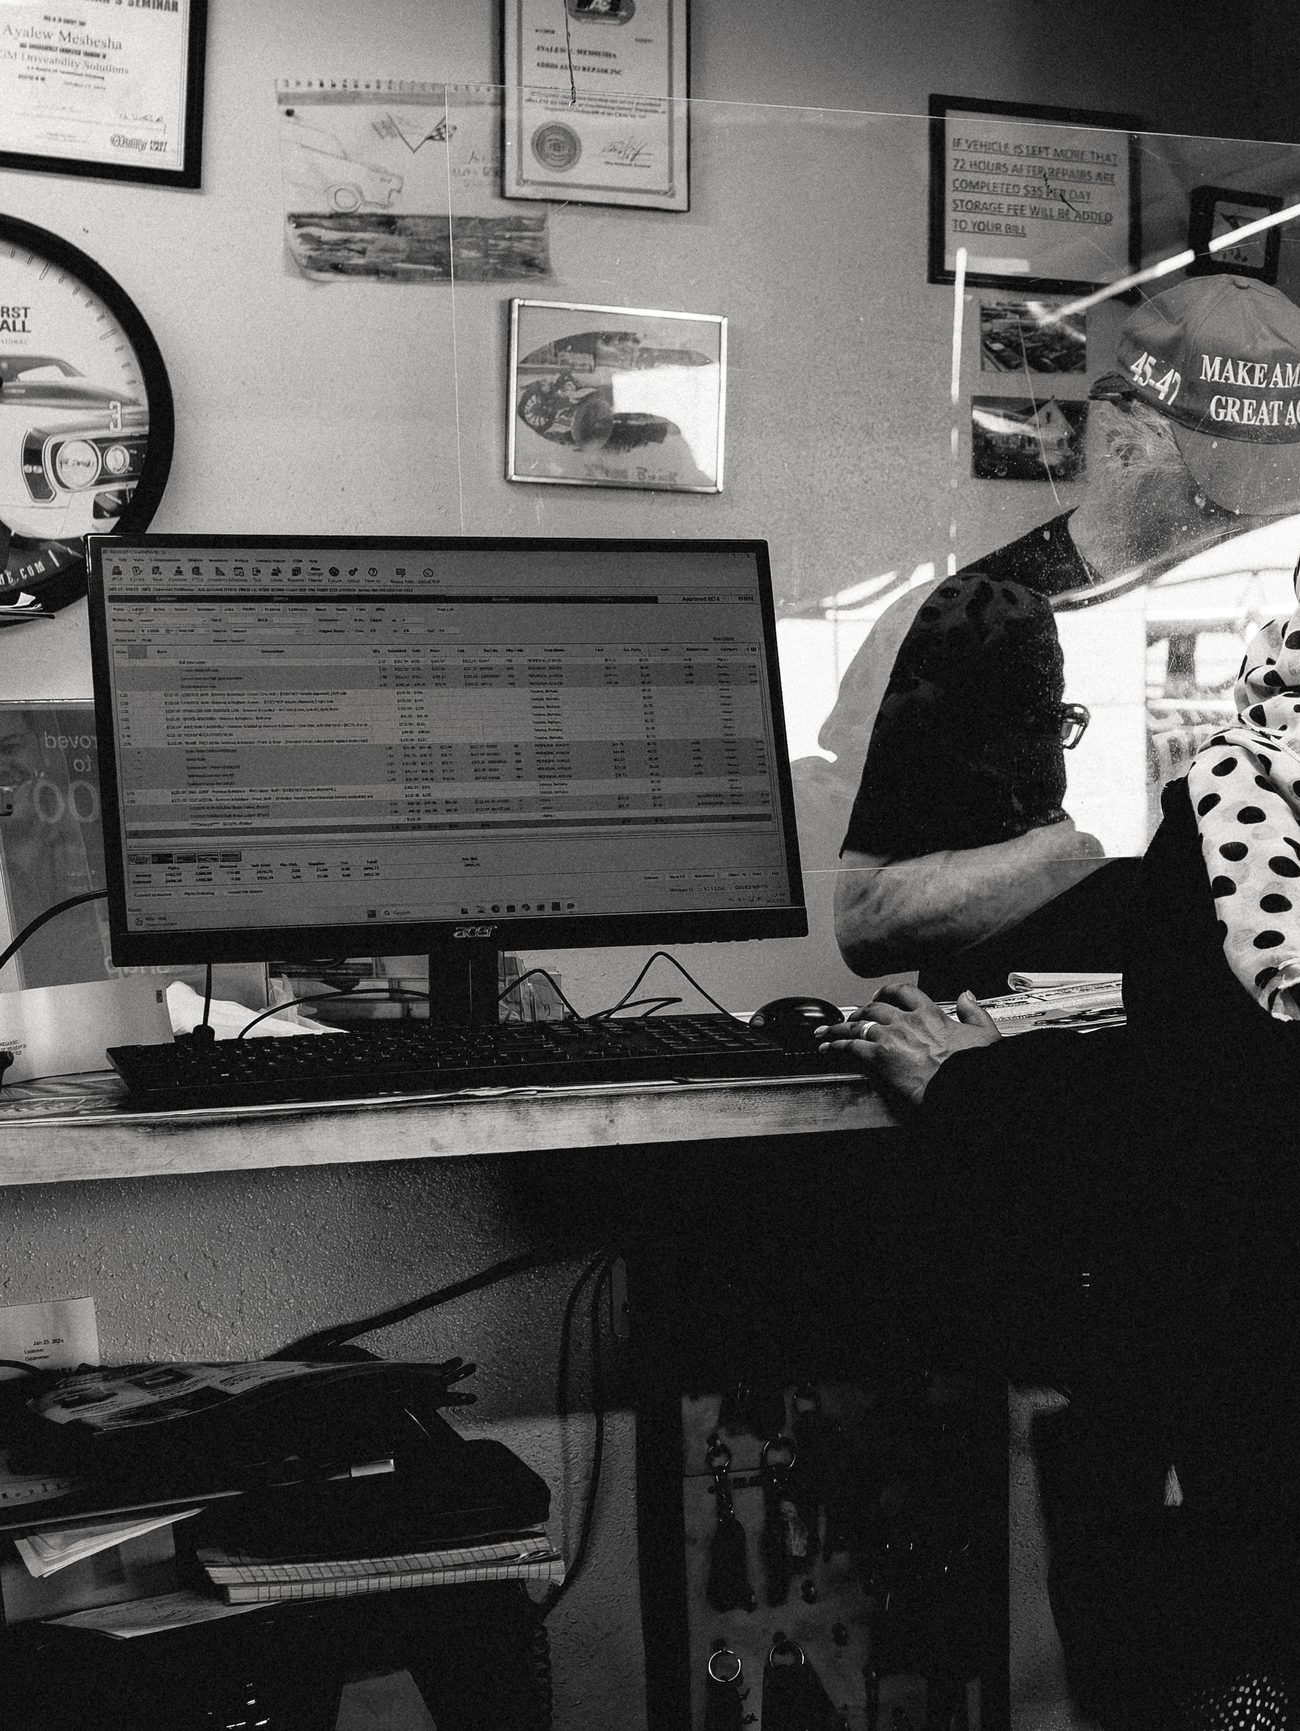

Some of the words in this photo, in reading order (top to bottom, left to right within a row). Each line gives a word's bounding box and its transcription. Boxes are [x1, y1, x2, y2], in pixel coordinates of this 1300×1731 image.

[3, 23, 54, 40] Ayalew
[59, 30, 122, 50] Meshesha
[953, 138, 960, 148] IF
[953, 158, 966, 169] 72
[970, 160, 1008, 173] HOURS
[953, 178, 1020, 195] COMPLETED
[953, 199, 1004, 213] STORAGE
[1007, 204, 1025, 216] FEE
[1029, 205, 1054, 218] WILL
[953, 219, 967, 230] TO
[971, 220, 1001, 232] YOUR
[1130, 351, 1182, 405] 45-47
[1200, 354, 1268, 388] MAKE
[109, 400, 121, 431] 3
[1210, 394, 1283, 426] GREAT
[454, 927, 497, 939] acer
